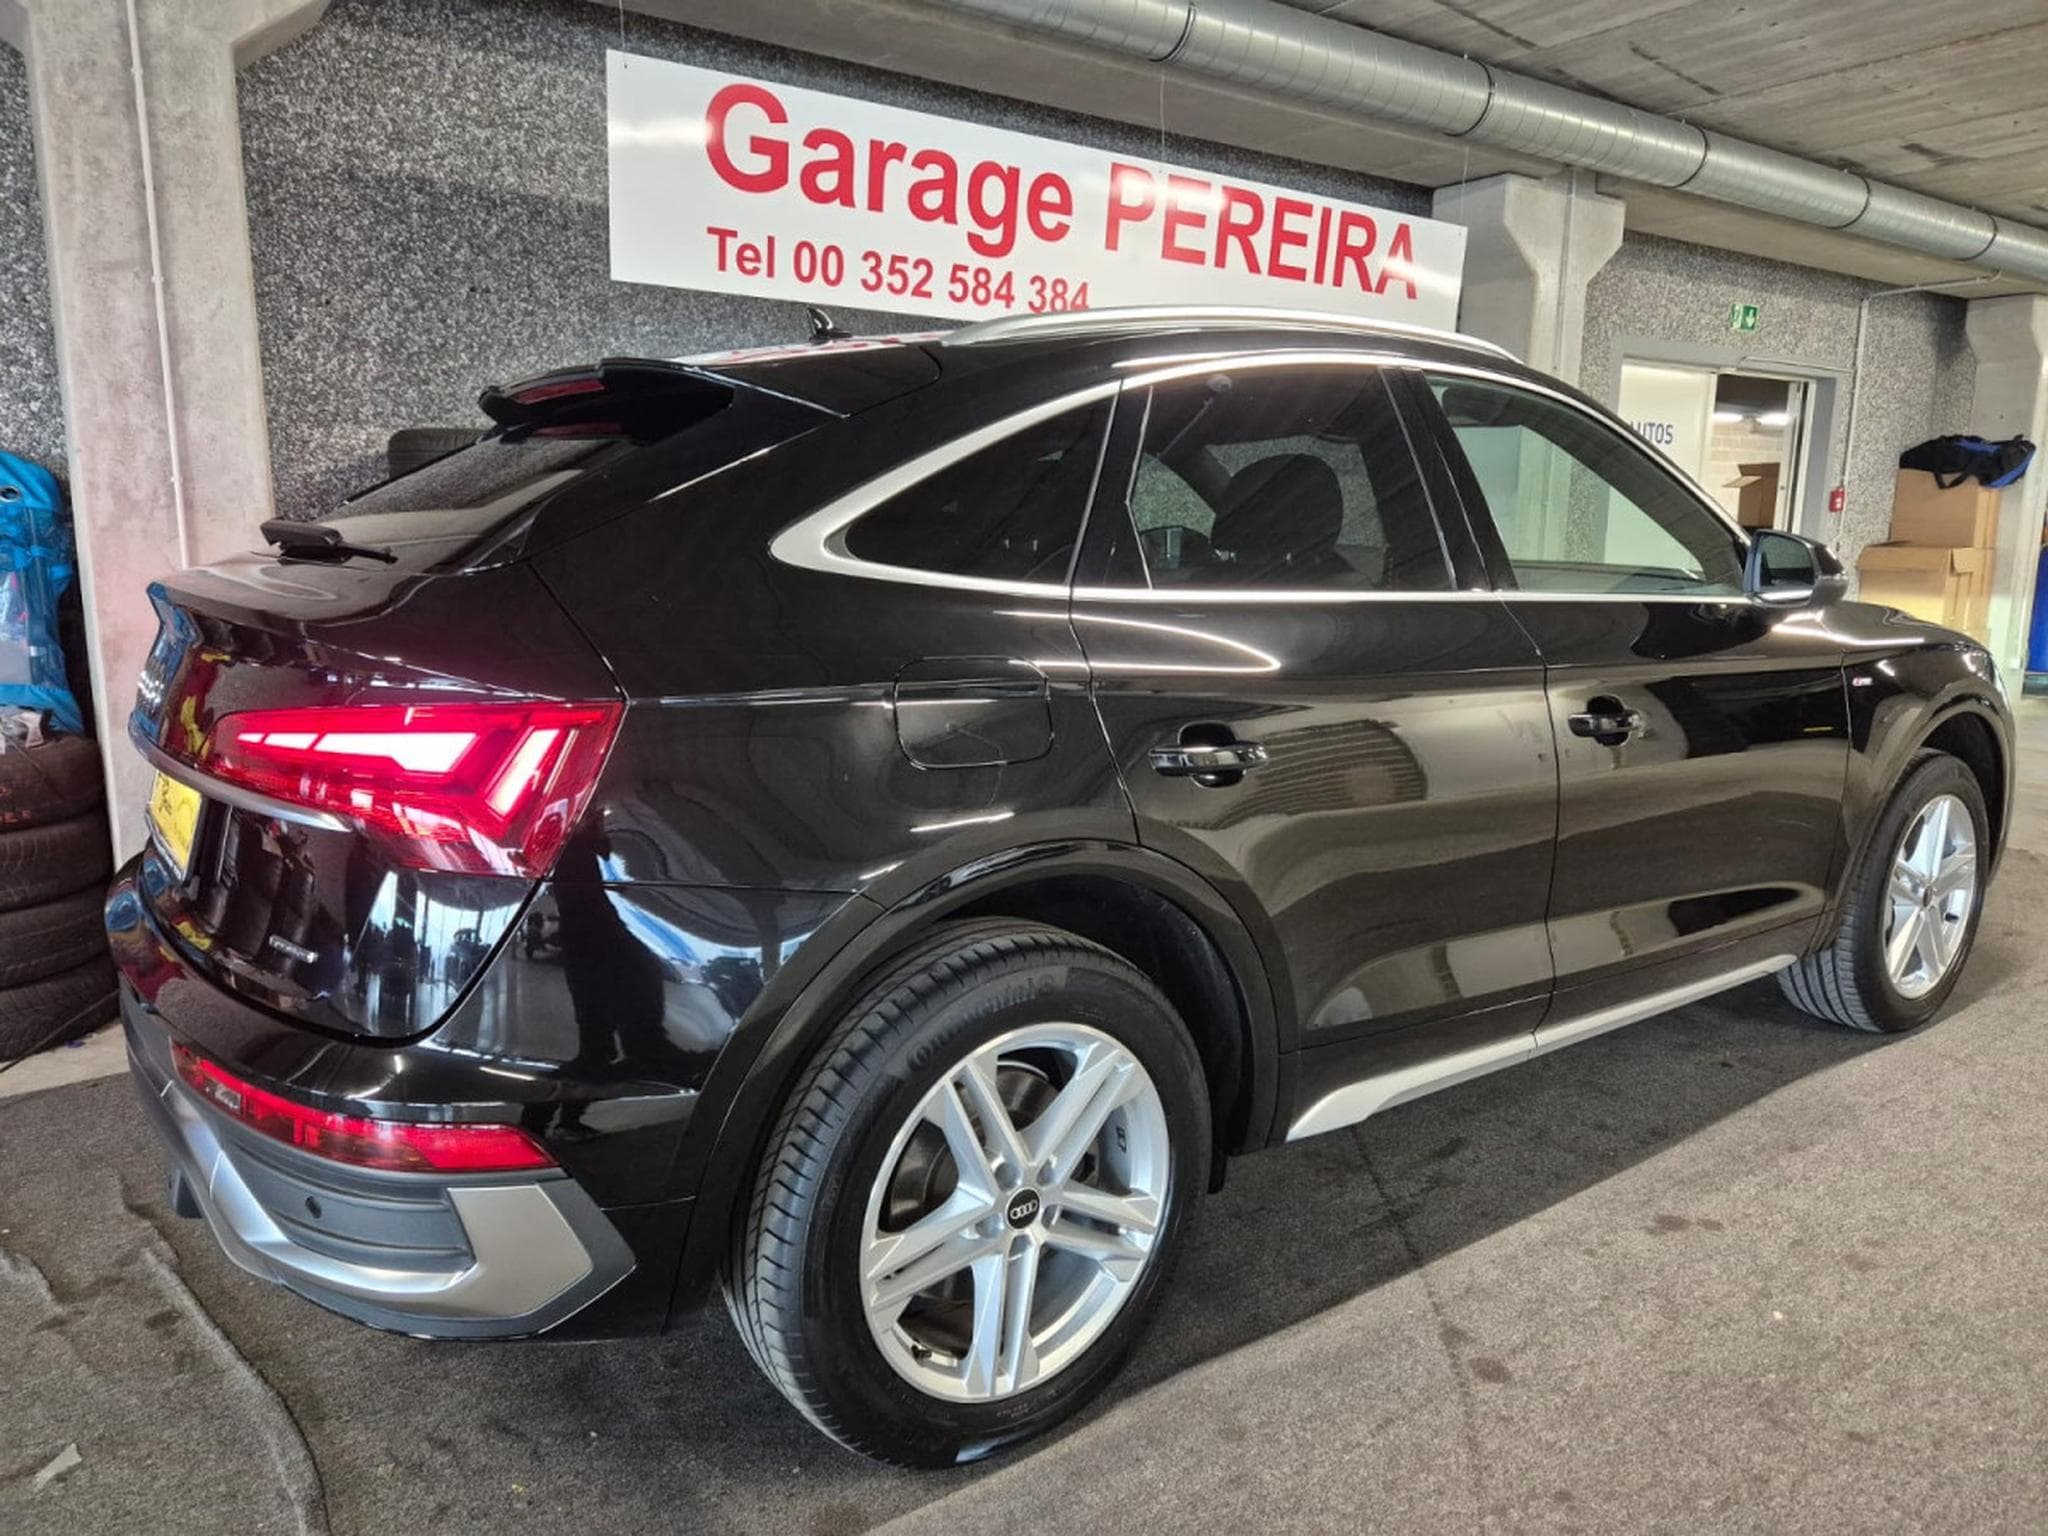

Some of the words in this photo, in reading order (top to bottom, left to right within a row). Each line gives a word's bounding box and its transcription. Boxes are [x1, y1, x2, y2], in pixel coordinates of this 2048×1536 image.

[705, 82, 1075, 260] Garage
[1104, 161, 1419, 300] PEREIRA
[706, 225, 777, 279] Tel
[792, 239, 846, 288] 00
[860, 249, 935, 300] 352
[947, 262, 1016, 309] 584
[1027, 273, 1089, 314] 384
